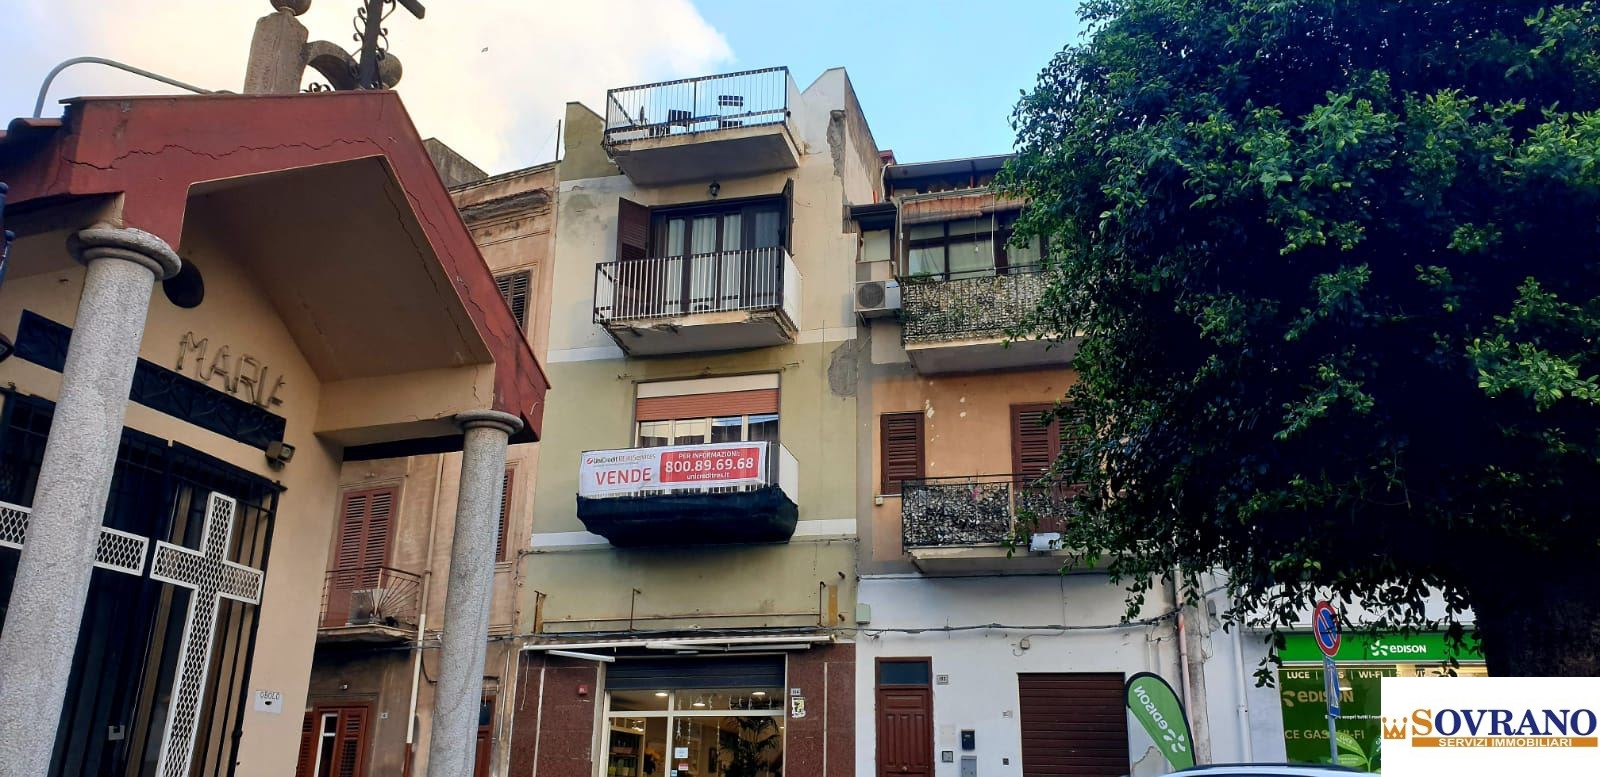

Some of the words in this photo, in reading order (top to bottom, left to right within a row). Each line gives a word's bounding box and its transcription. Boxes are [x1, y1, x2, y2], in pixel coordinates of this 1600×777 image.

[678, 452, 692, 460] PER
[665, 457, 754, 473] 800.89.69.68
[595, 467, 652, 486] VENDE
[1286, 671, 1311, 679] LUCE
[1358, 671, 1383, 679] WI-FI
[1284, 730, 1300, 739] CE
[1303, 730, 1330, 739] GAS
